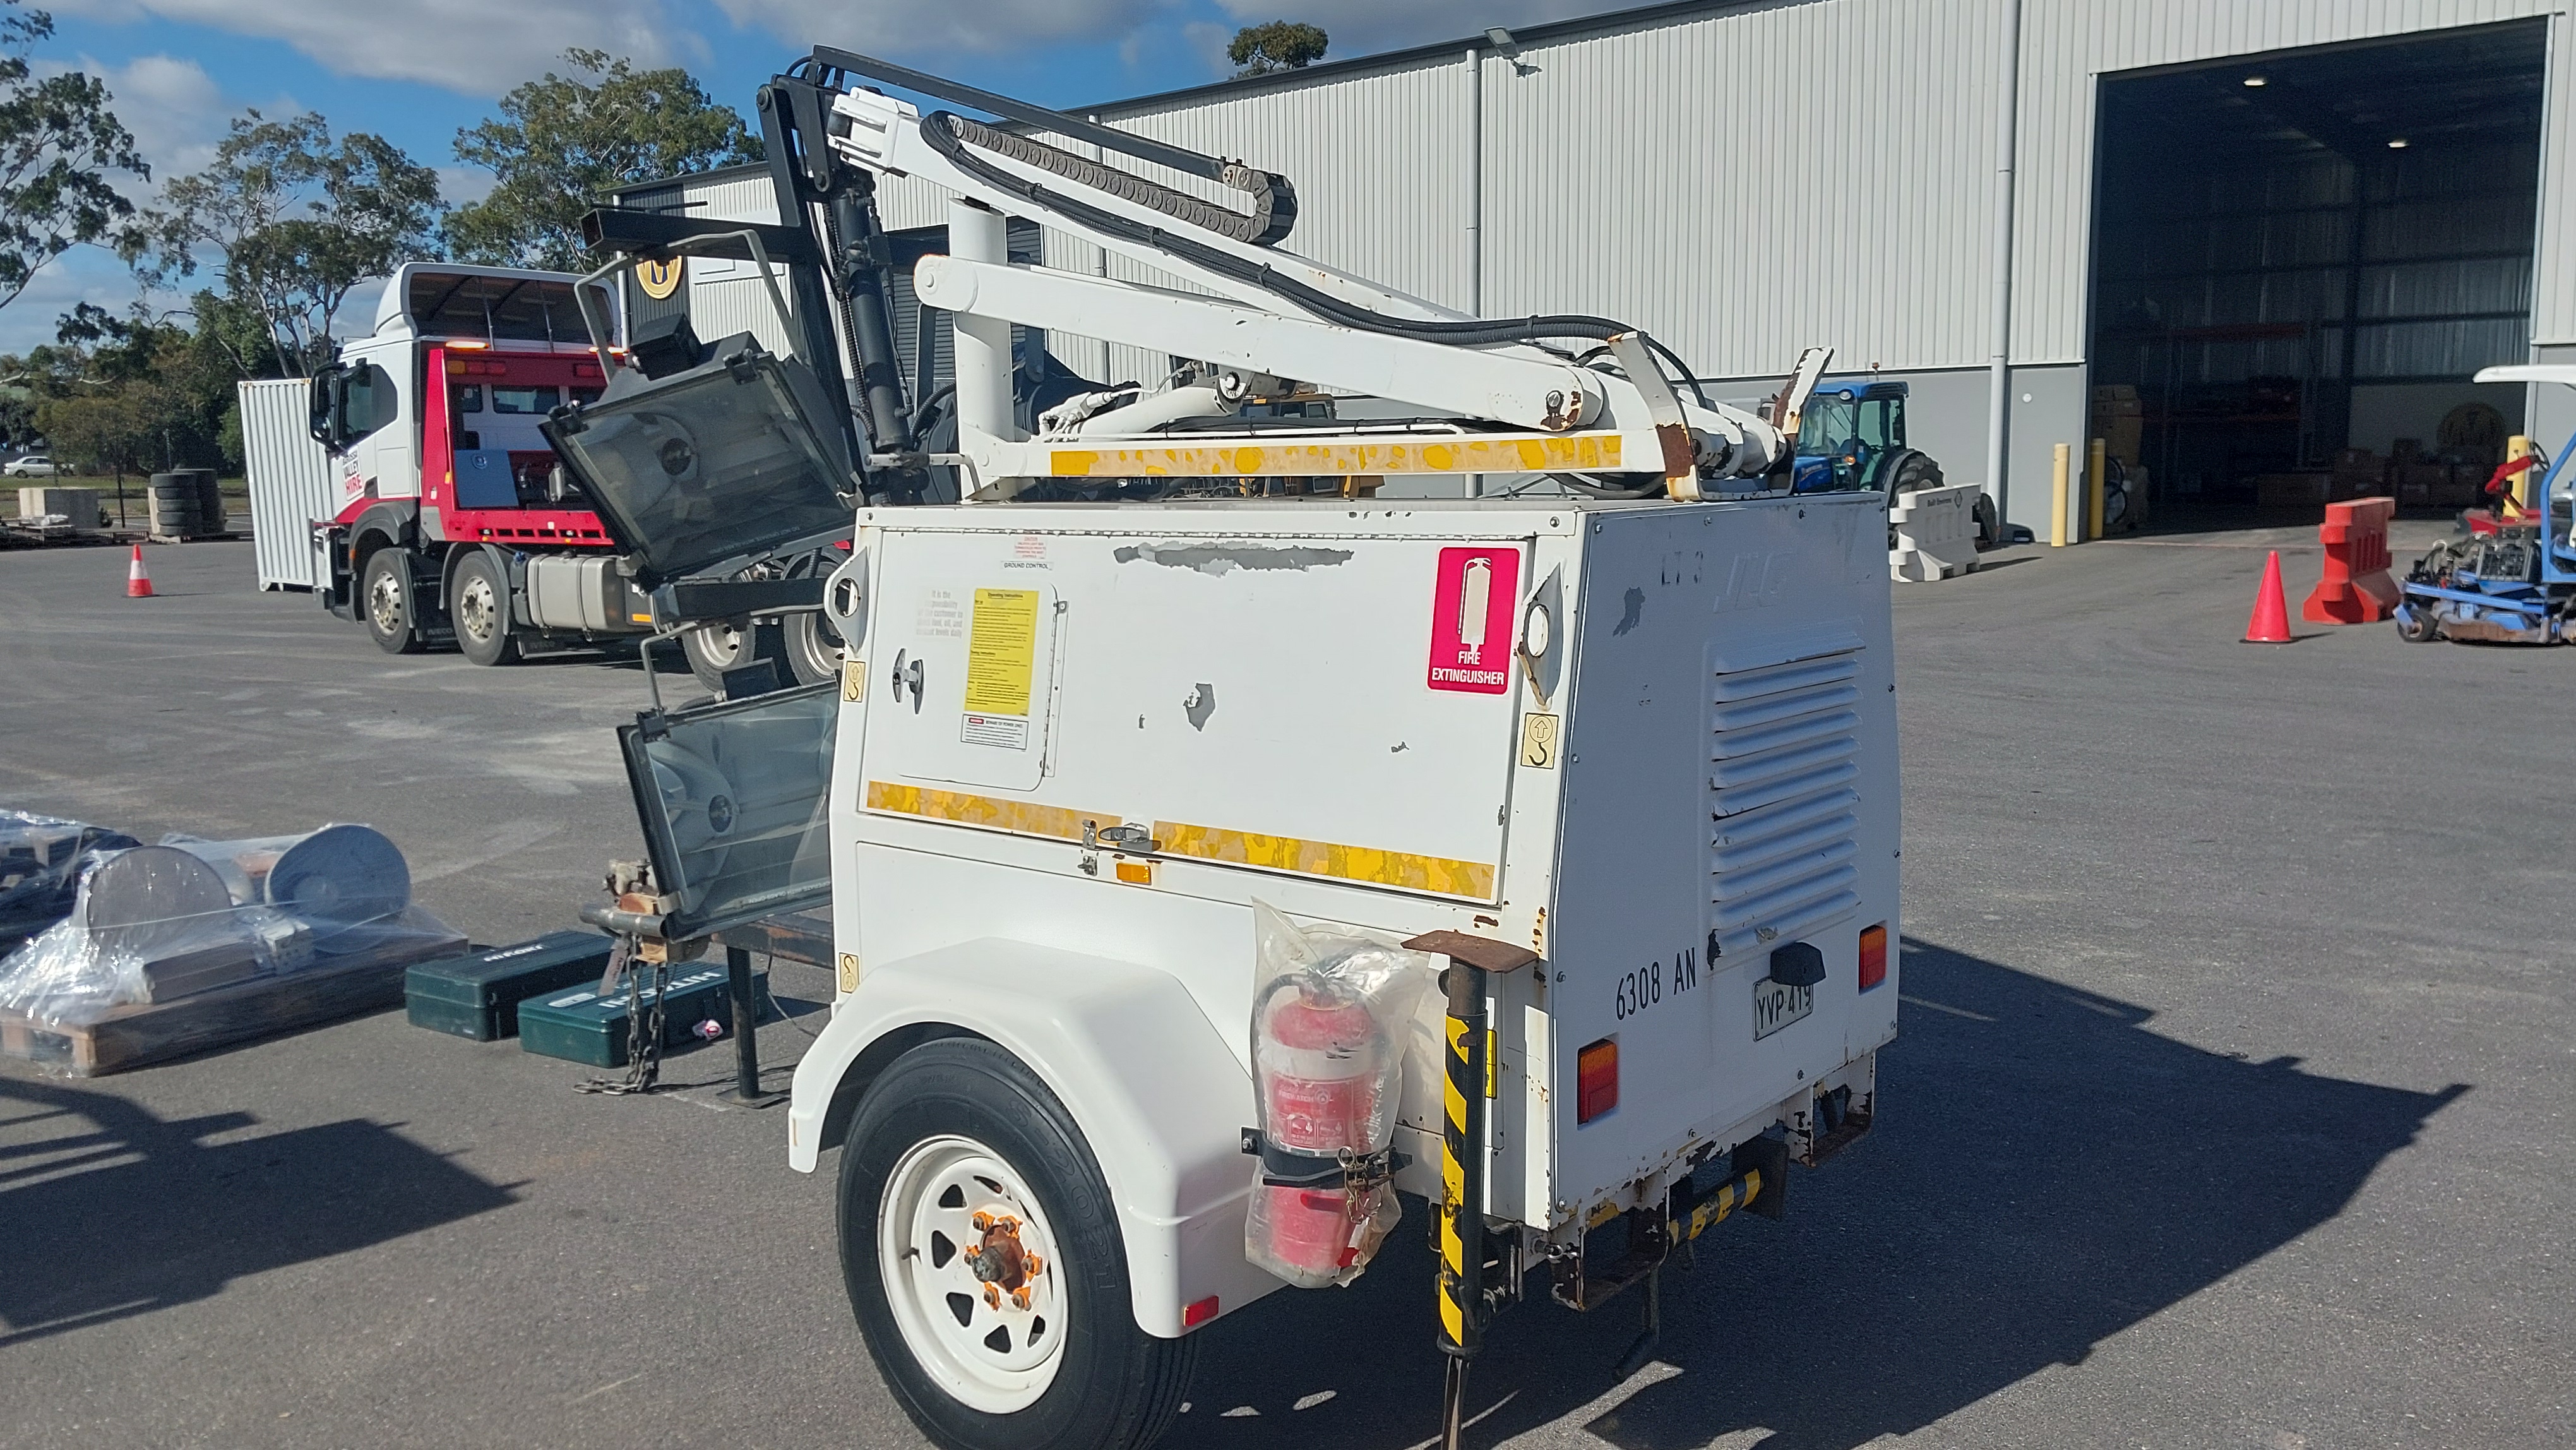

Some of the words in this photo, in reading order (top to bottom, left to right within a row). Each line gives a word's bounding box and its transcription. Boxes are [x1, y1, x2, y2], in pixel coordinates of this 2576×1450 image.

[345, 474, 362, 496] HIRE
[1457, 650, 1481, 666] FIRE
[1431, 667, 1505, 686] EXTINGUISHER
[1616, 961, 1661, 1021] 6308
[1673, 947, 1696, 995] AN
